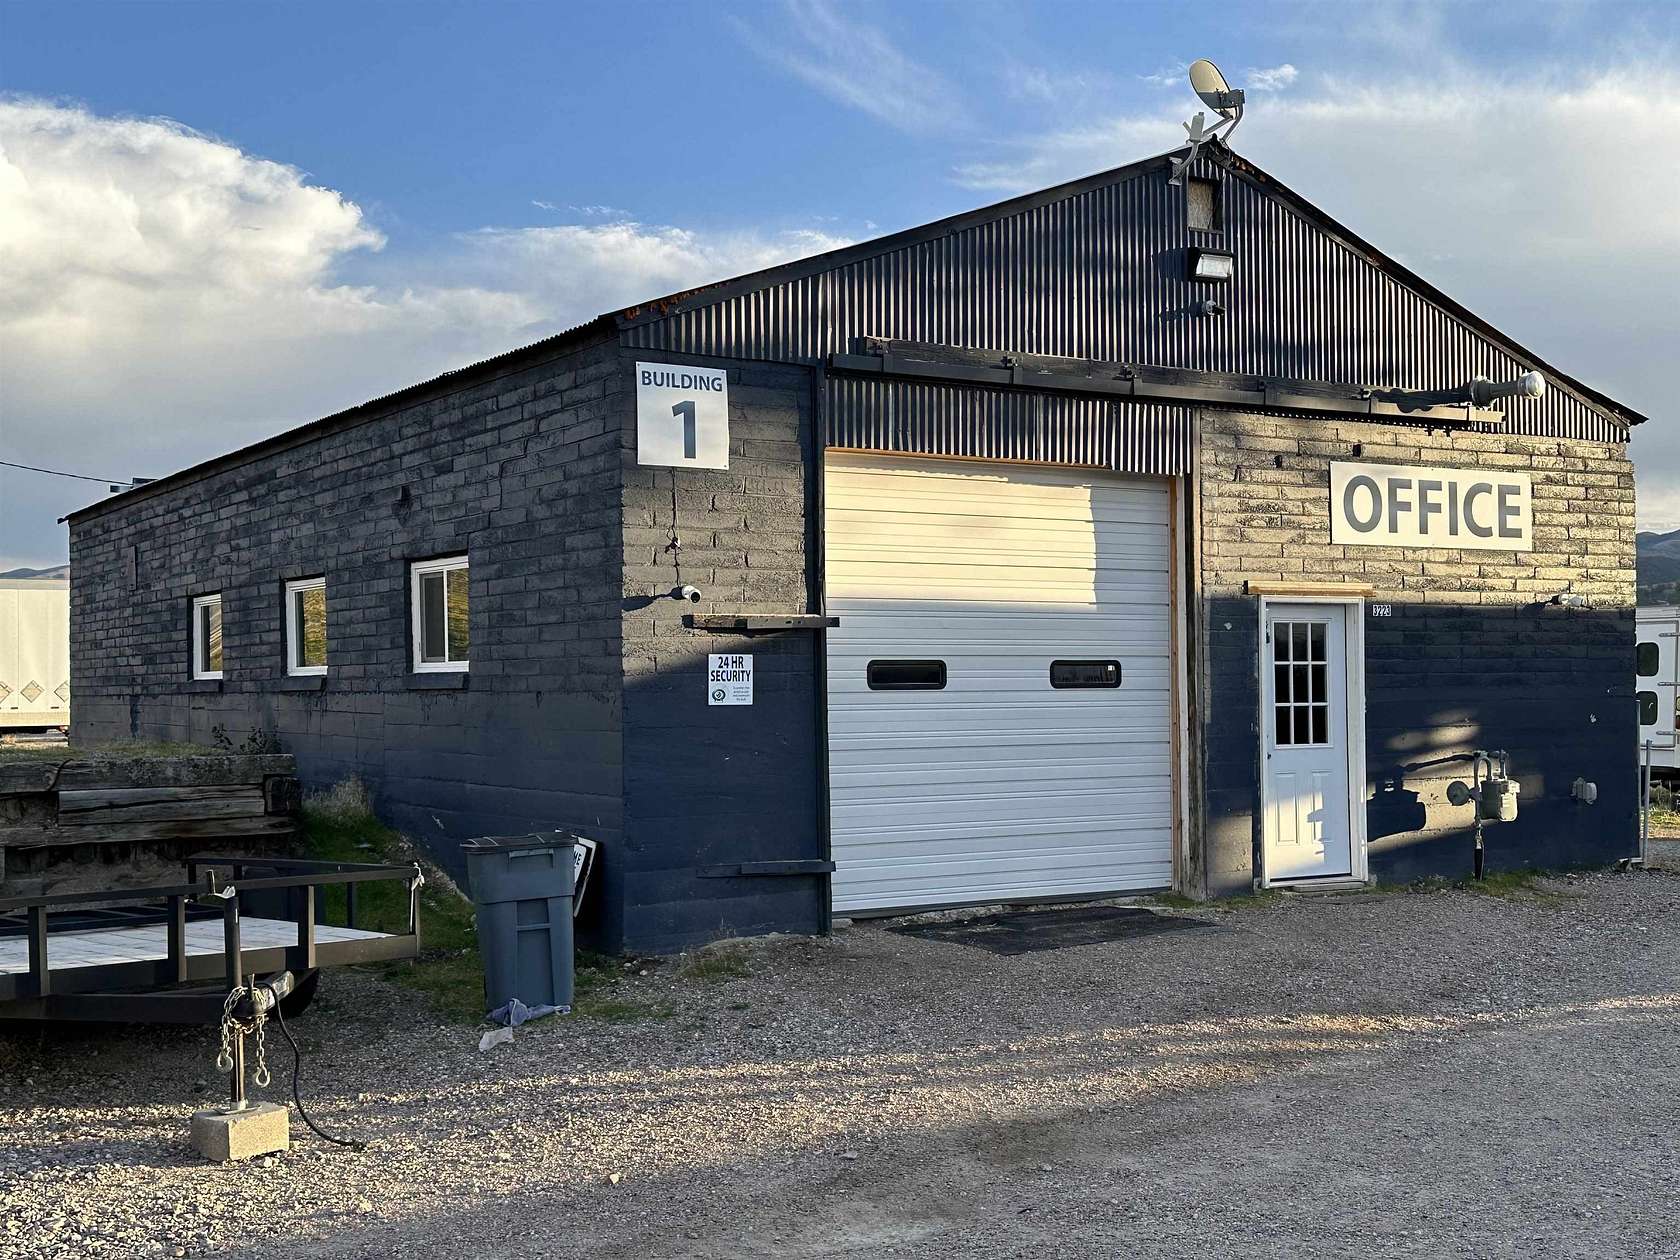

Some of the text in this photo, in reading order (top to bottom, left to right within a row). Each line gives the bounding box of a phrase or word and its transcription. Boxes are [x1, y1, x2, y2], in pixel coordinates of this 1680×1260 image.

[641, 370, 723, 392] BUILDING
[671, 400, 697, 459] 1
[1343, 474, 1523, 539] OFFICE
[718, 656, 744, 669] 24 HR
[710, 670, 751, 682] SECURITY
